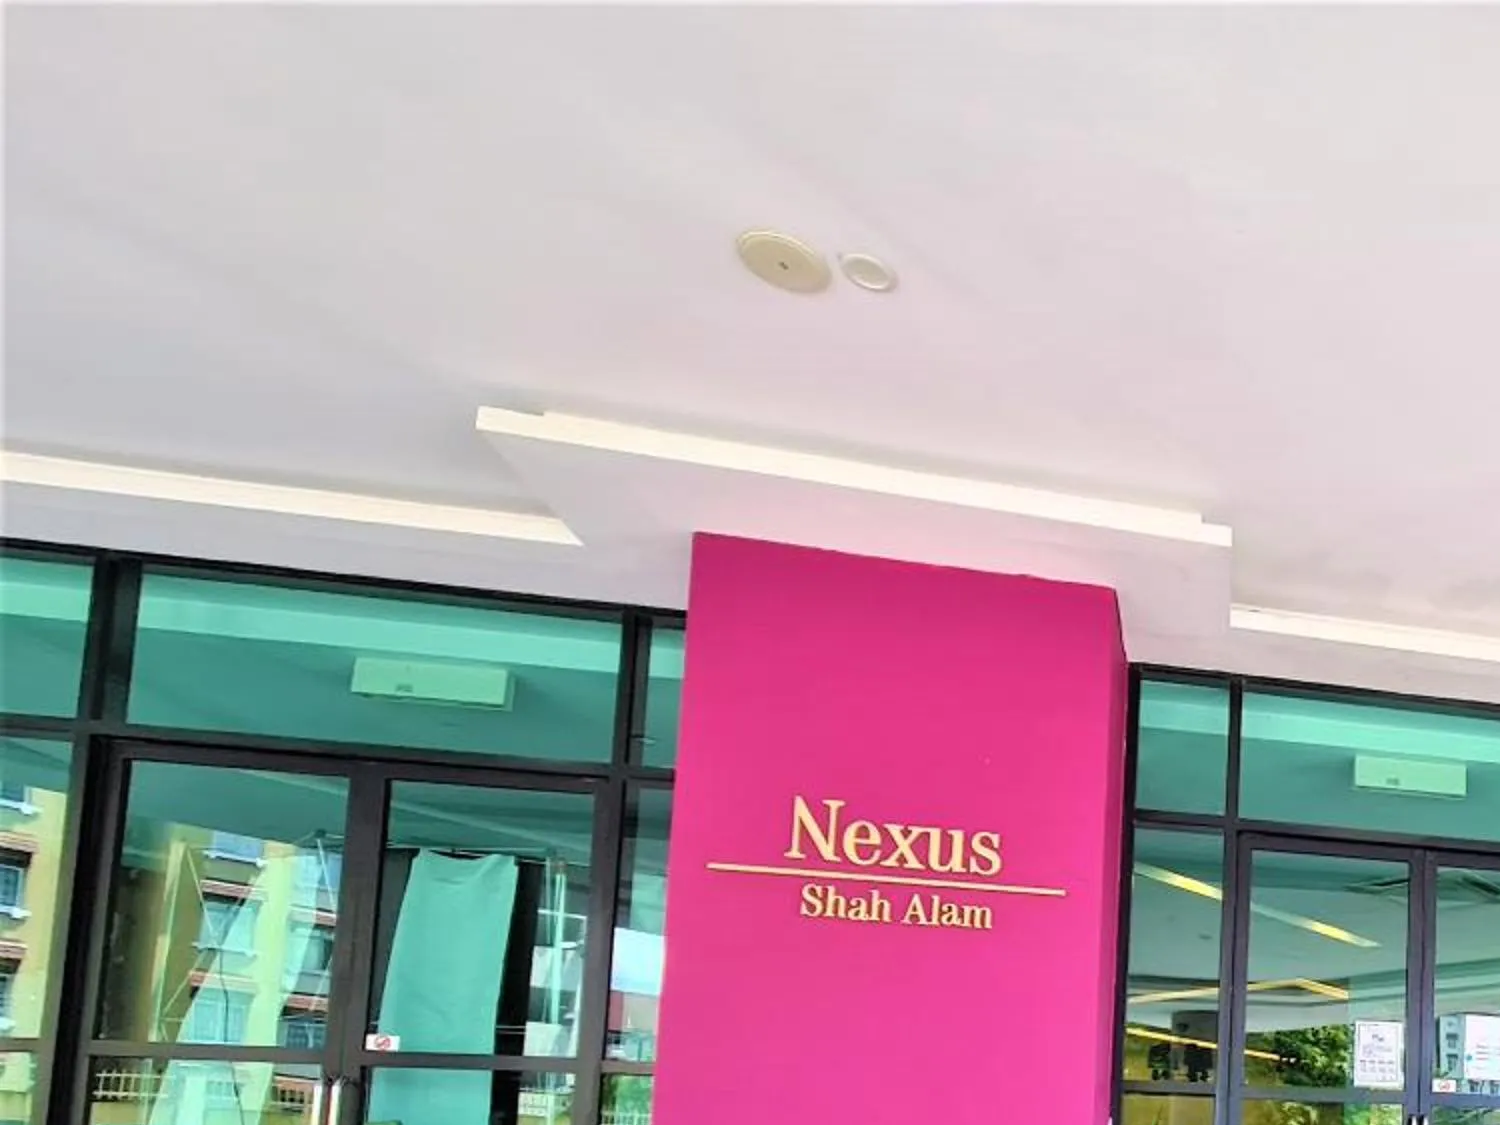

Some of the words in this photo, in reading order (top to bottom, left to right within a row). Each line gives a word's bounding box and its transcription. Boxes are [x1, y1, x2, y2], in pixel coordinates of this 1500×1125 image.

[784, 795, 1001, 876] Nexus
[801, 883, 892, 922] Shah
[902, 893, 993, 929] Alam
